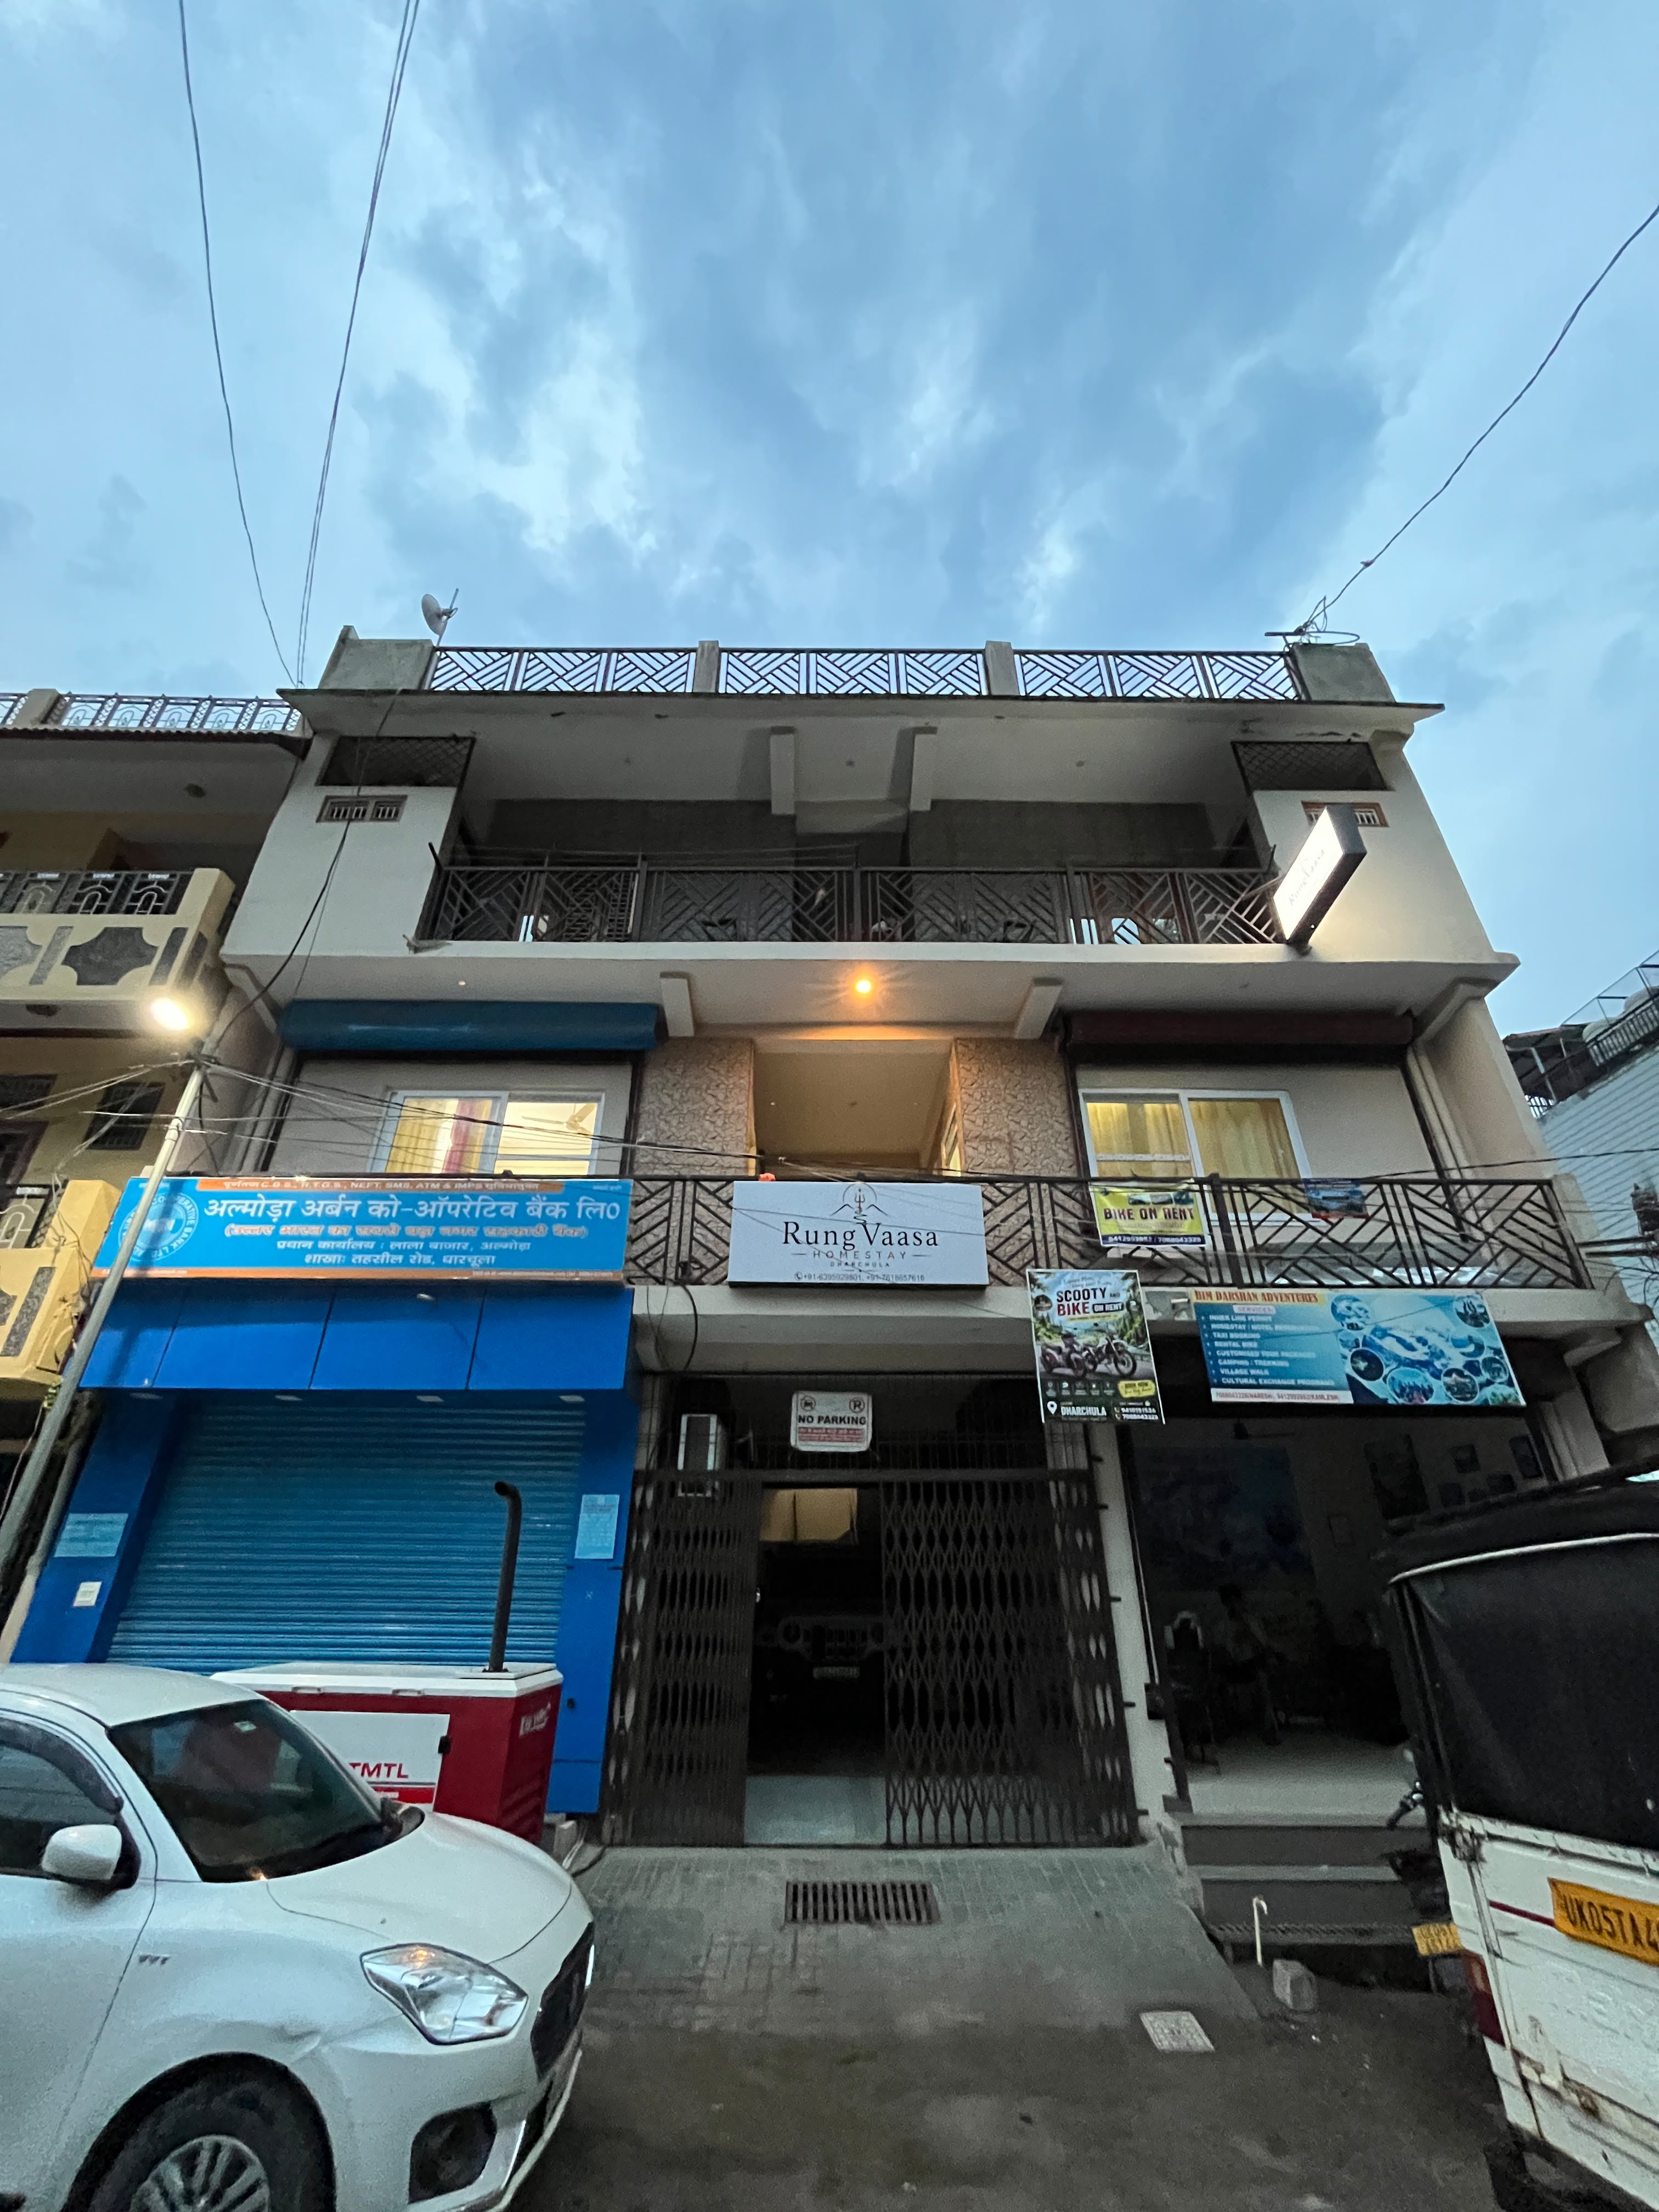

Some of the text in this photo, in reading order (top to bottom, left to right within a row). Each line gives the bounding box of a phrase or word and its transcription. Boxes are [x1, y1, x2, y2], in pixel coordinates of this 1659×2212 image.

[204, 1193, 297, 1222] अल्मोड़ा
[302, 1194, 362, 1218] अर्बन
[525, 1194, 569, 1219] बैंक
[1104, 1208, 1194, 1220] BIKE ON RENT
[813, 1250, 907, 1260] HOMESTAY
[1057, 1288, 1107, 1302] SCOOTY
[1216, 1291, 1259, 1302] DARSHAN
[1262, 1293, 1319, 1304] ADVENTURES
[1058, 1302, 1090, 1316] BIKE
[1060, 1406, 1107, 1416] DHARCHULA
[798, 1415, 867, 1425] NO PARKING
